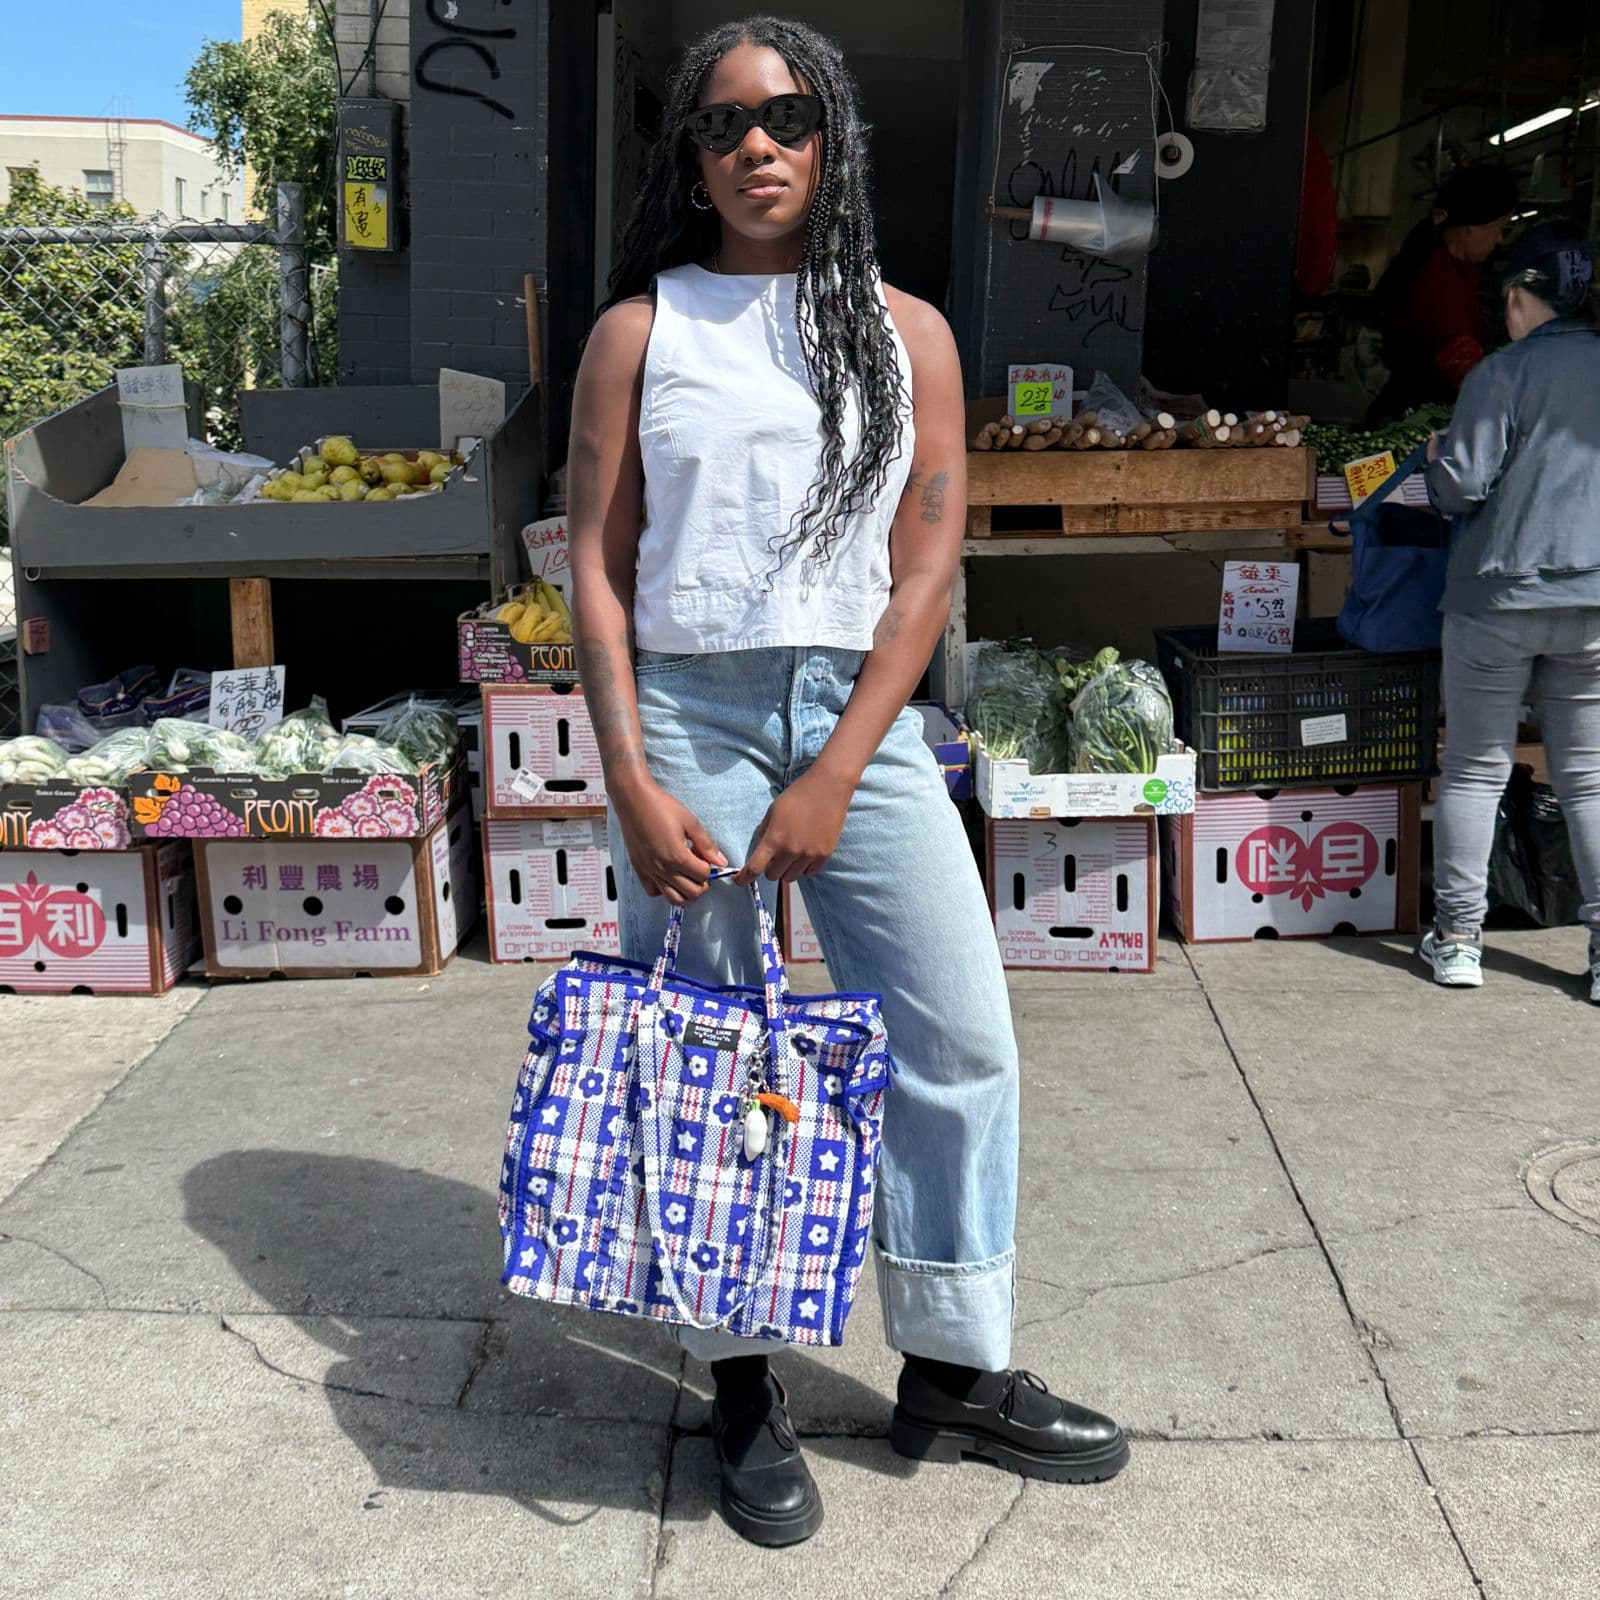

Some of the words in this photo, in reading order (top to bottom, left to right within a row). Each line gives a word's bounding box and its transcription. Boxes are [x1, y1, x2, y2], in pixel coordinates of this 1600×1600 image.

[244, 799, 318, 834] PEONY
[1248, 834, 1365, 883] 百利
[242, 864, 380, 891] 利豐農場
[222, 920, 248, 942] Li
[256, 920, 328, 947] Fong
[334, 920, 411, 942] Farm
[1099, 932, 1143, 948] BALLY
